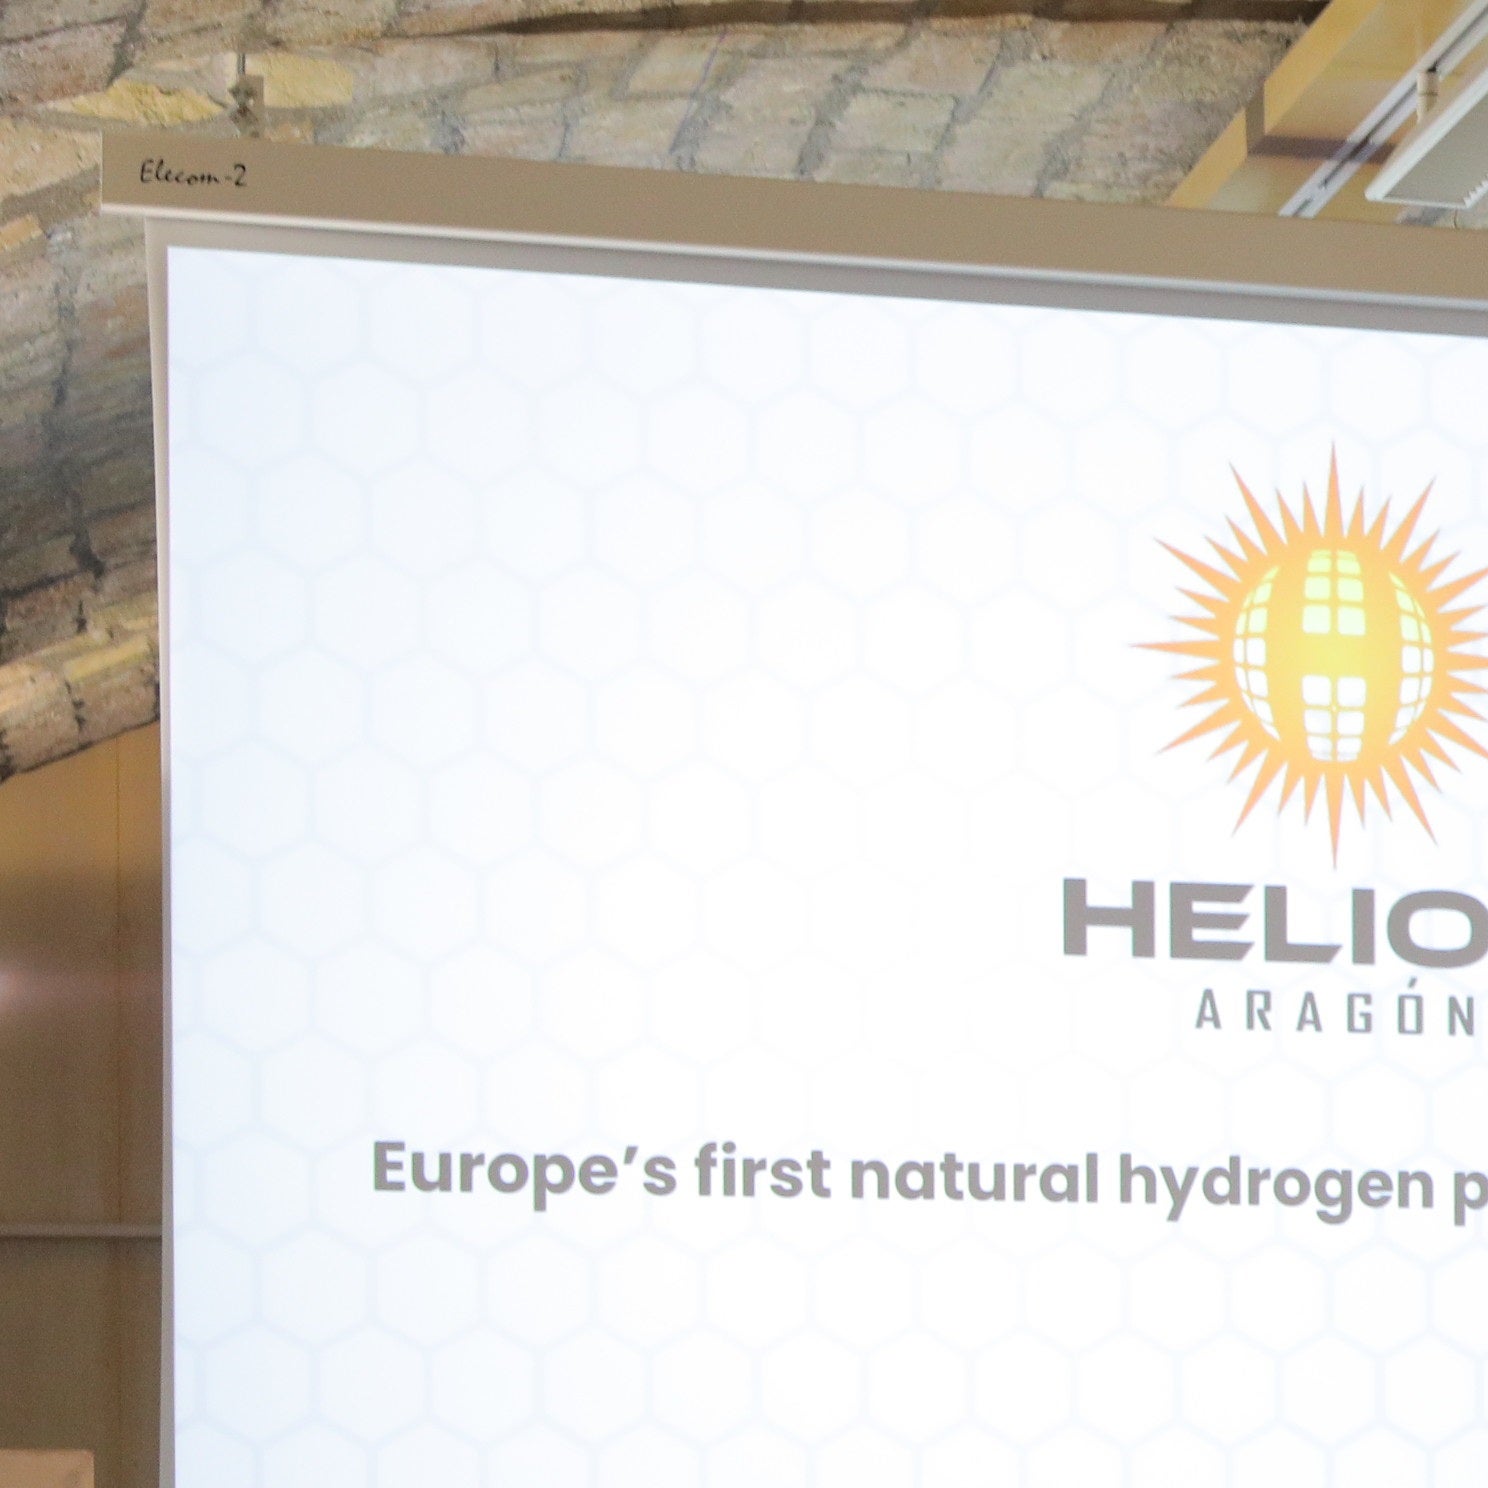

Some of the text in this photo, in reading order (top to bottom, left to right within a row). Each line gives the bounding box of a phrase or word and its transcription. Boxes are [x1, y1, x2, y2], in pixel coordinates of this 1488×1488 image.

[1195, 977, 1475, 1036] ARAGÓN
[373, 1140, 677, 1213] Europe’s
[694, 1141, 832, 1199] first
[851, 1152, 1098, 1203] natural
[1119, 1153, 1434, 1225] hydrogen
